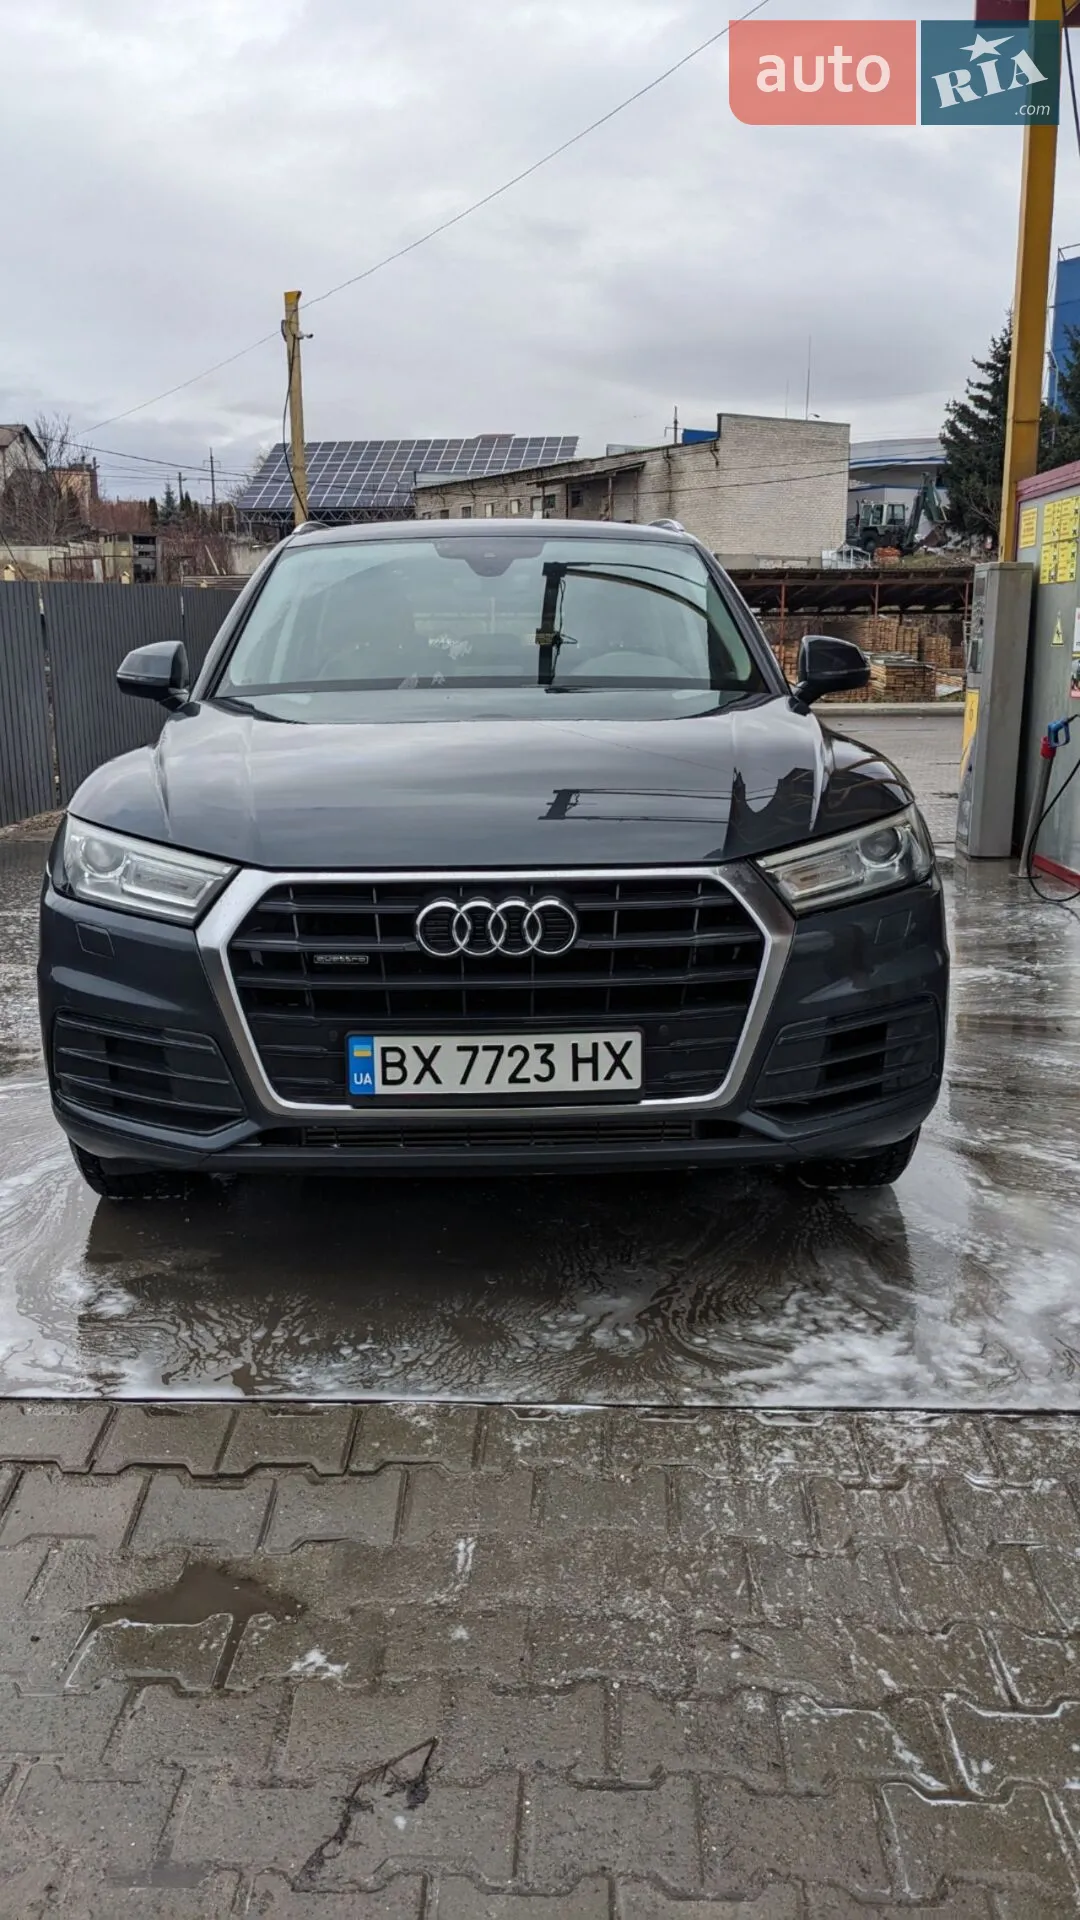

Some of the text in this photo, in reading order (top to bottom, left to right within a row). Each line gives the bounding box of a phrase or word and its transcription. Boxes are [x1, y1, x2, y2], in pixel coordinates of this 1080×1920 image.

[380, 1040, 634, 1086] BX 7723 HX
[353, 1072, 373, 1085] UA
